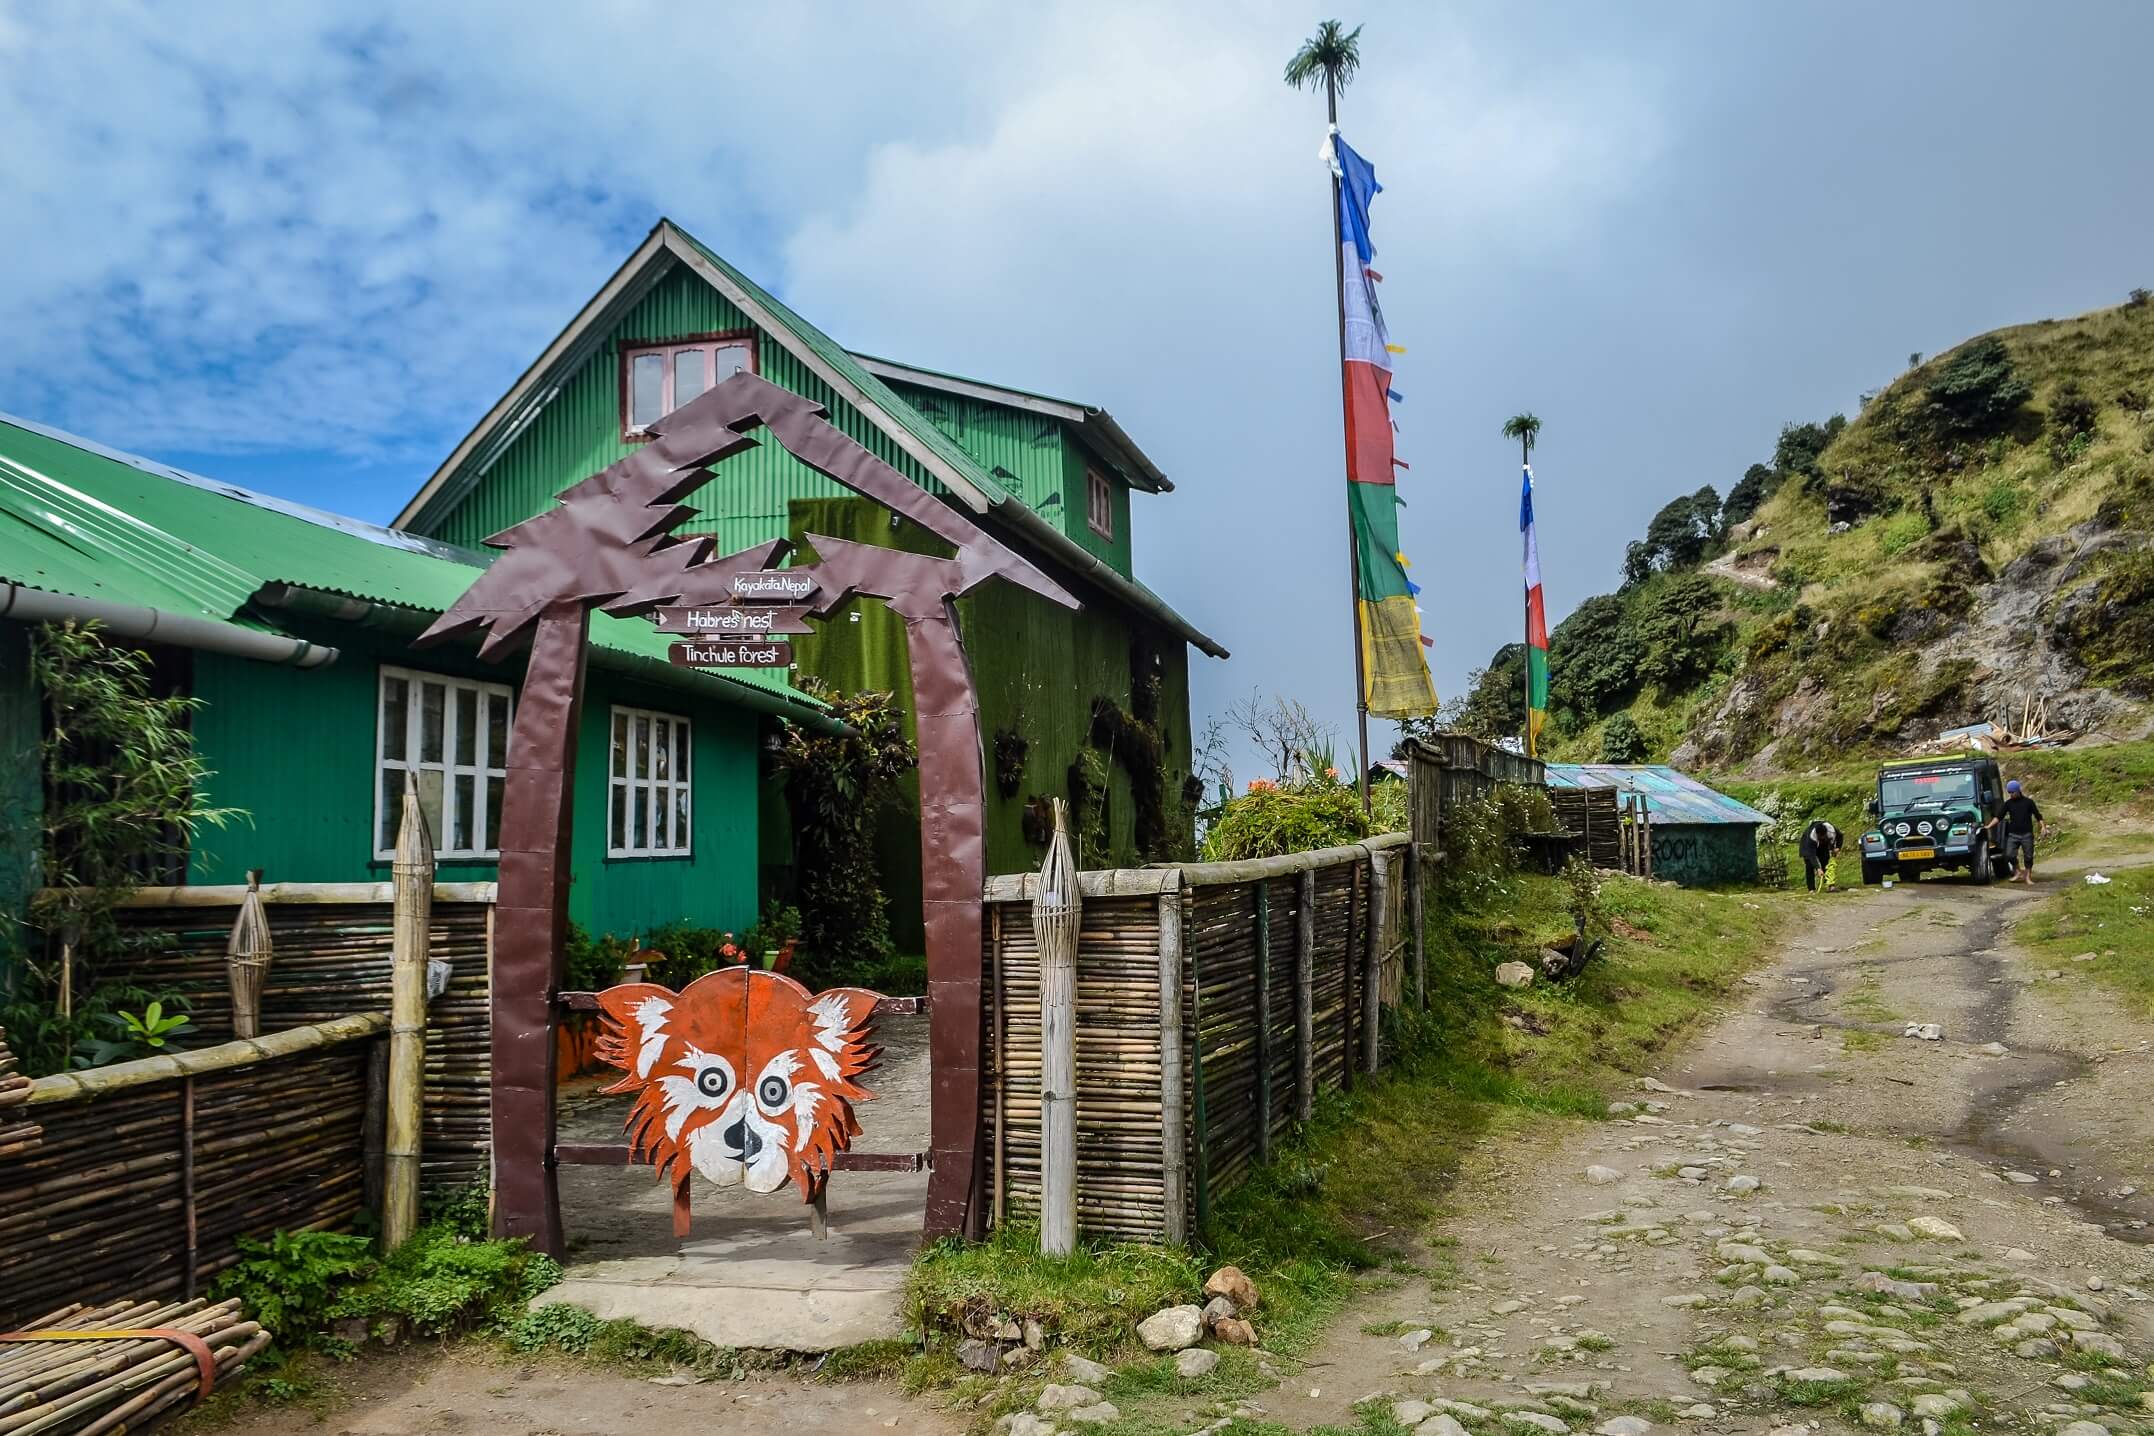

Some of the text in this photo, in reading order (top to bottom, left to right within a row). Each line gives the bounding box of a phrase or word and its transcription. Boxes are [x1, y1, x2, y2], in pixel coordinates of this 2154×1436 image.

[743, 610, 778, 629] nest
[681, 644, 779, 663] Tinchule forest
[1651, 838, 1698, 864] ROOM
